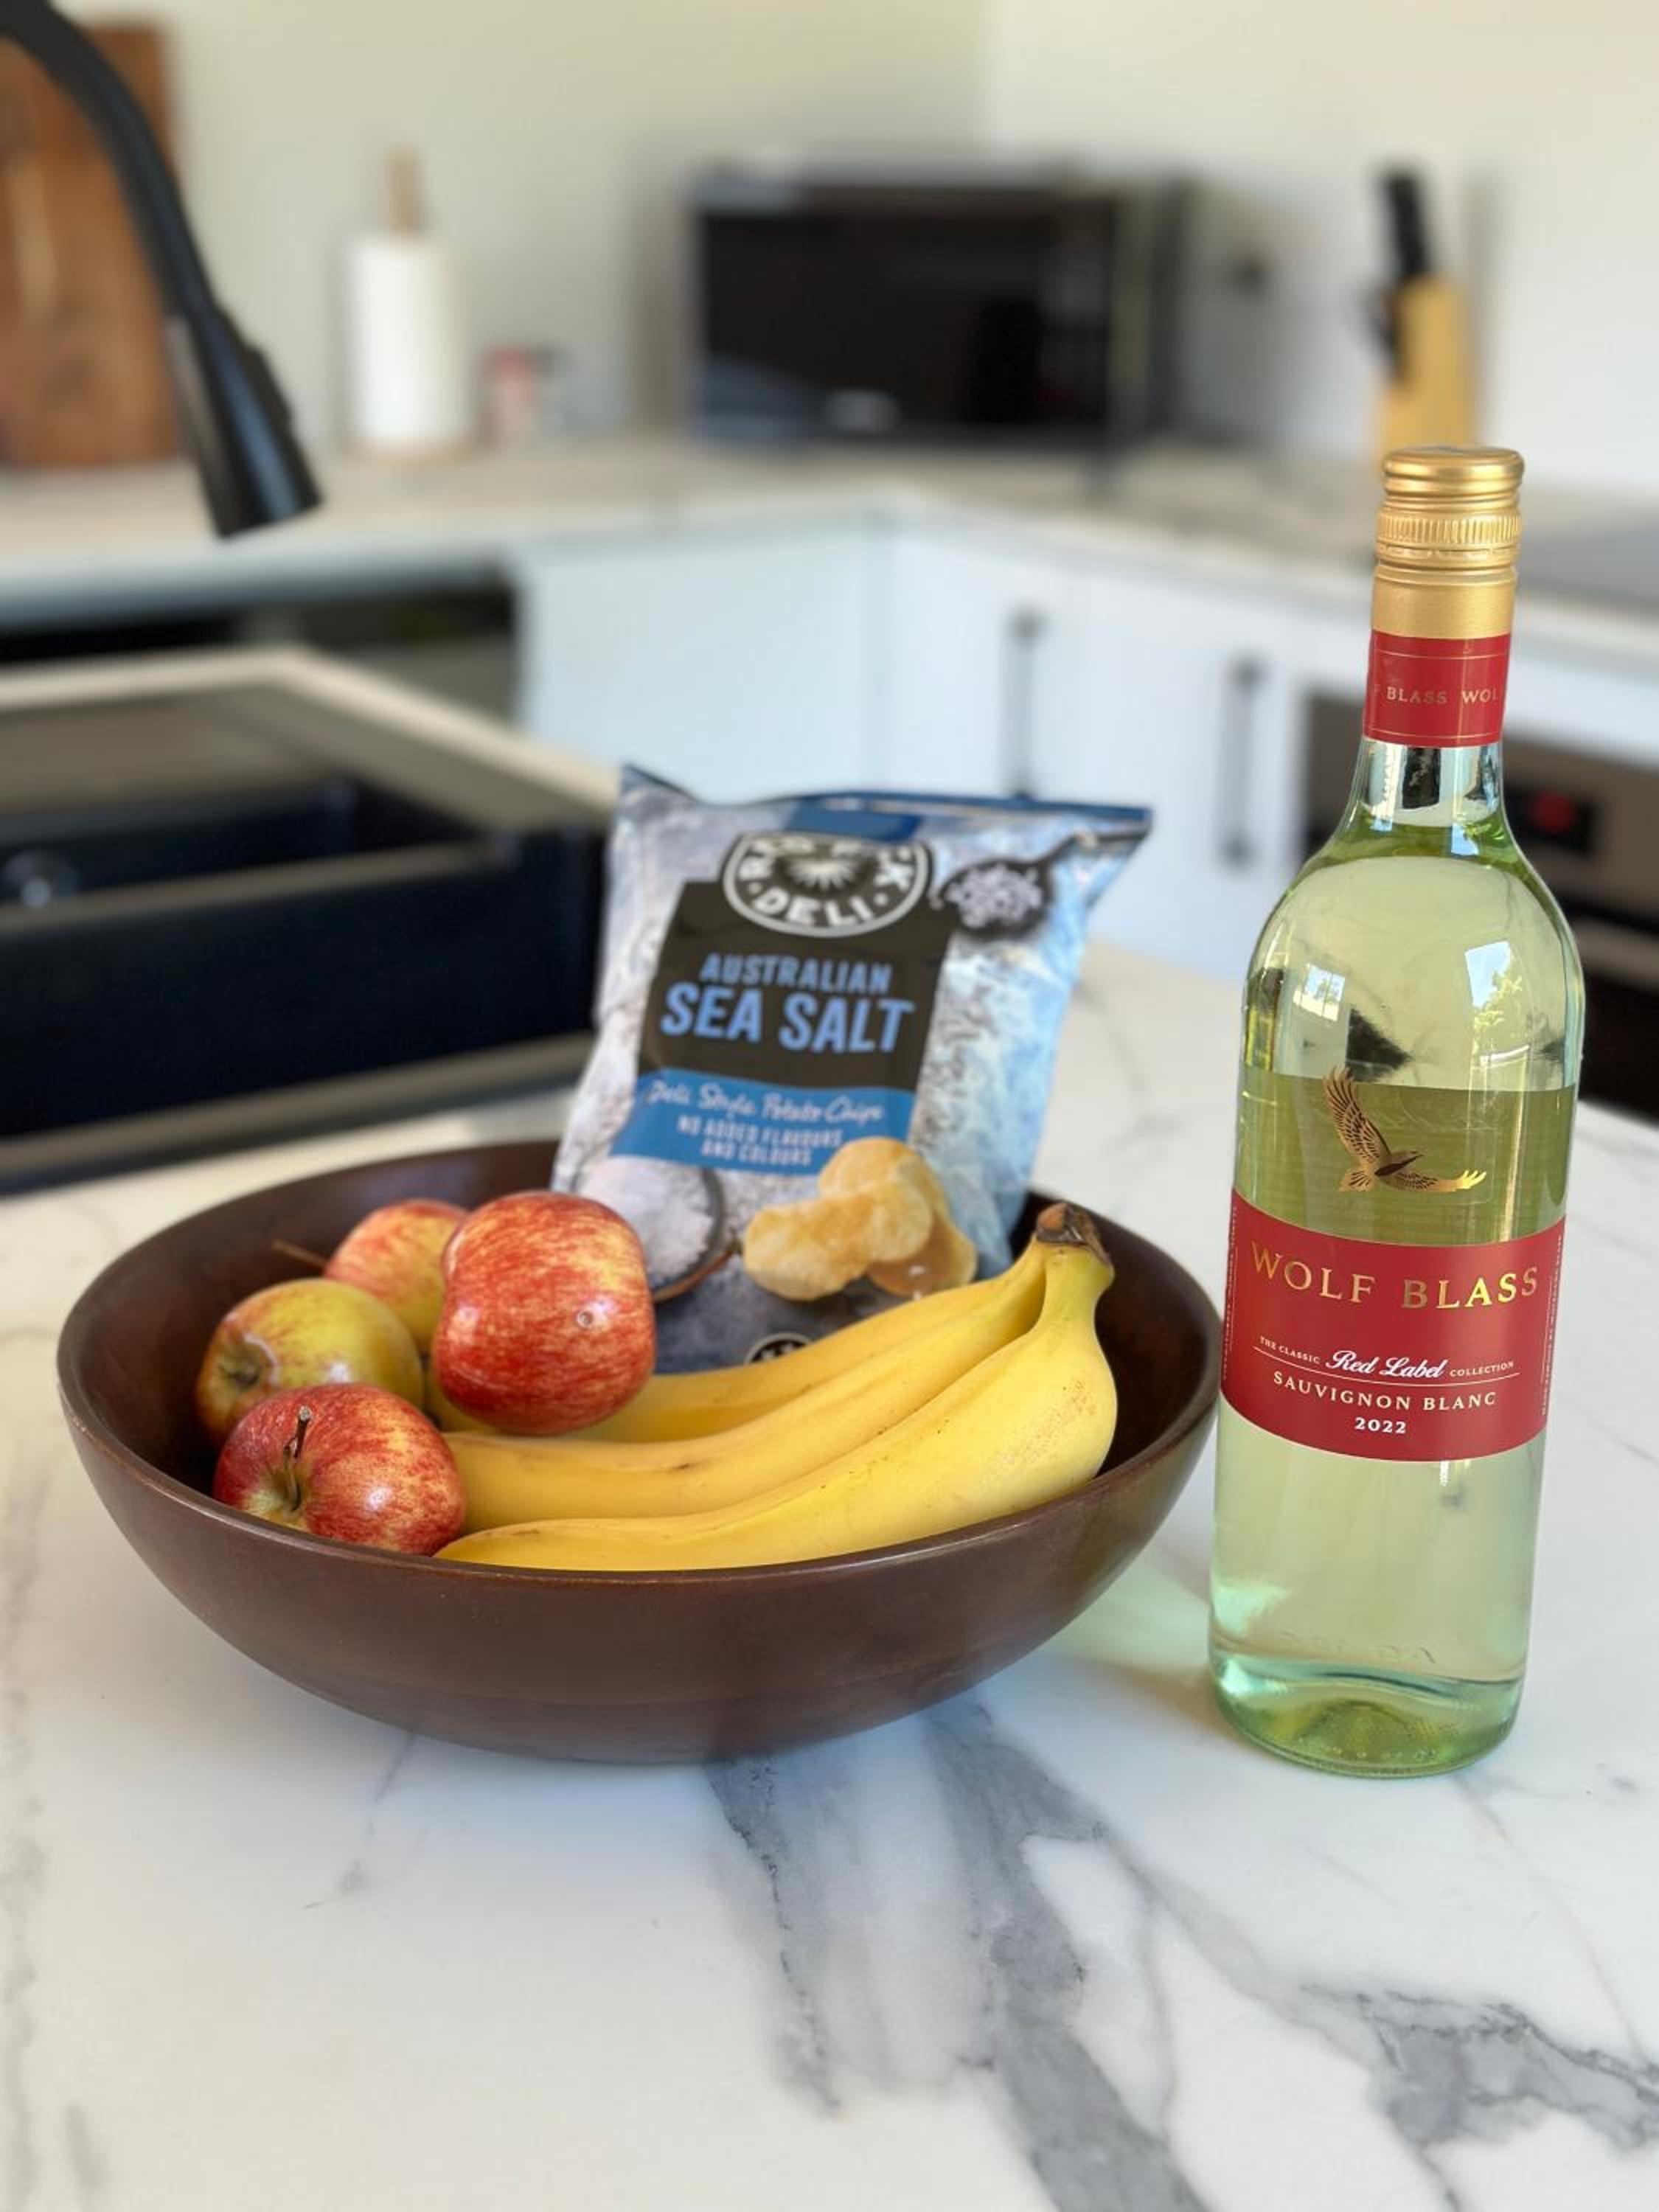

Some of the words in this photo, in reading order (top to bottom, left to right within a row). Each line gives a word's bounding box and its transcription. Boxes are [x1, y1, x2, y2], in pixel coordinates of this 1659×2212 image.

[1387, 686, 1447, 704] BLASS
[1461, 686, 1498, 704] WOL
[752, 886, 875, 926] DELI
[700, 952, 894, 995] AUSTRALIAN
[661, 981, 764, 1043] SEA
[778, 992, 917, 1053] SALT
[641, 1079, 691, 1105] Deli
[698, 1082, 756, 1119] Style
[760, 1092, 824, 1122] Potato
[823, 1095, 883, 1127] Chips
[676, 1115, 701, 1136] NO
[703, 1119, 758, 1144] ADDED
[760, 1126, 843, 1148] FLAVOURS
[701, 1138, 736, 1160] AND
[738, 1142, 811, 1166] COLOURS
[1252, 1241, 1375, 1304] WOLF
[1402, 1267, 1539, 1310] BLASS
[1260, 1336, 1277, 1351] THE
[1279, 1345, 1321, 1364] CLASSIC
[1326, 1349, 1379, 1375] Red
[1379, 1357, 1448, 1379] Label
[1450, 1360, 1514, 1377] COLLECTION
[1273, 1371, 1411, 1411] SAUVIGNON
[1423, 1391, 1497, 1411] BLANC
[1354, 1416, 1407, 1434] 2022
